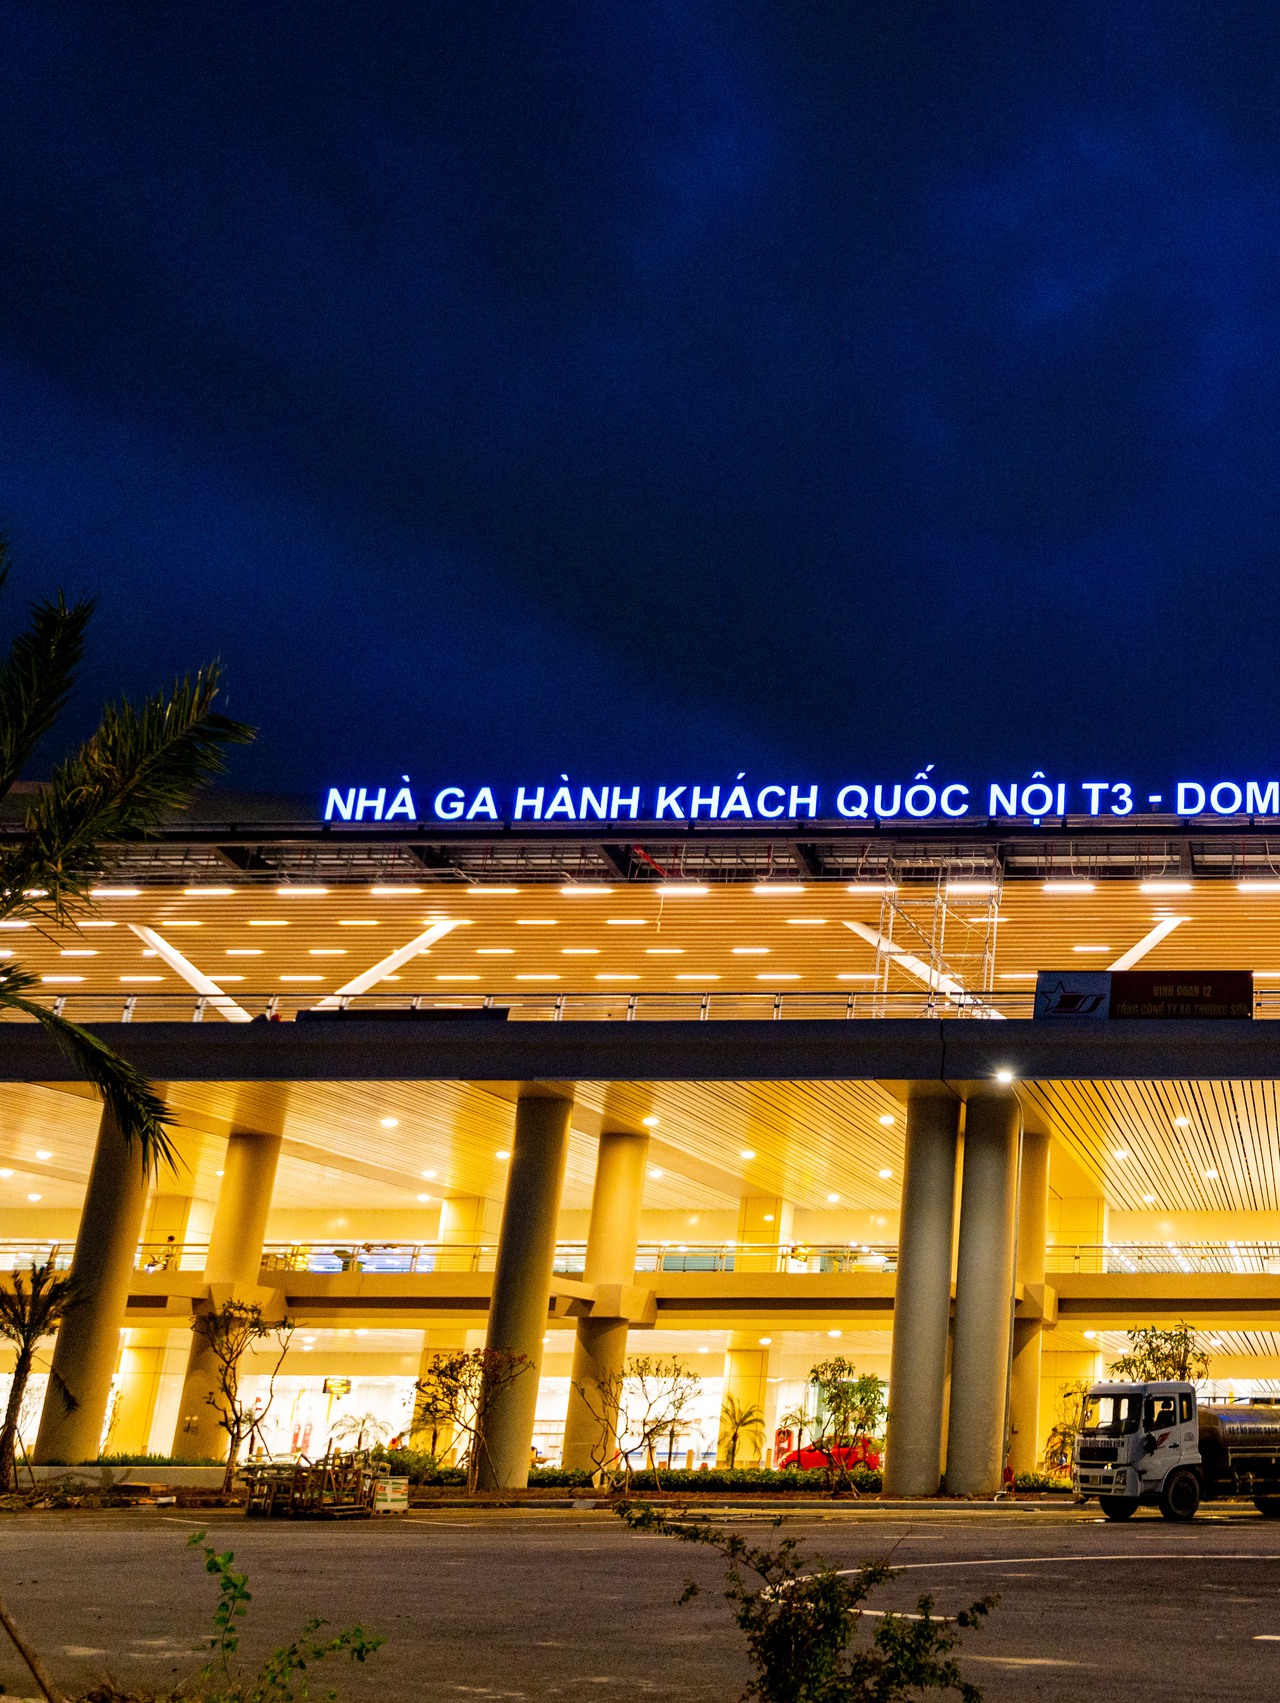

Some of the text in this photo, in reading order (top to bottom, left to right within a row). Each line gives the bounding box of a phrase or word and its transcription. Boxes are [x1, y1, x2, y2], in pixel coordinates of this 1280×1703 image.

[324, 774, 417, 820] NHÀ
[434, 787, 498, 820] GA
[514, 774, 640, 819] HÀNH
[655, 772, 819, 819] KHÁCH
[836, 764, 970, 819] QUỐC
[989, 771, 1066, 825] NỘI
[1081, 782, 1133, 816] T3
[1148, 795, 1162, 803] -
[1202, 984, 1213, 997] 12
